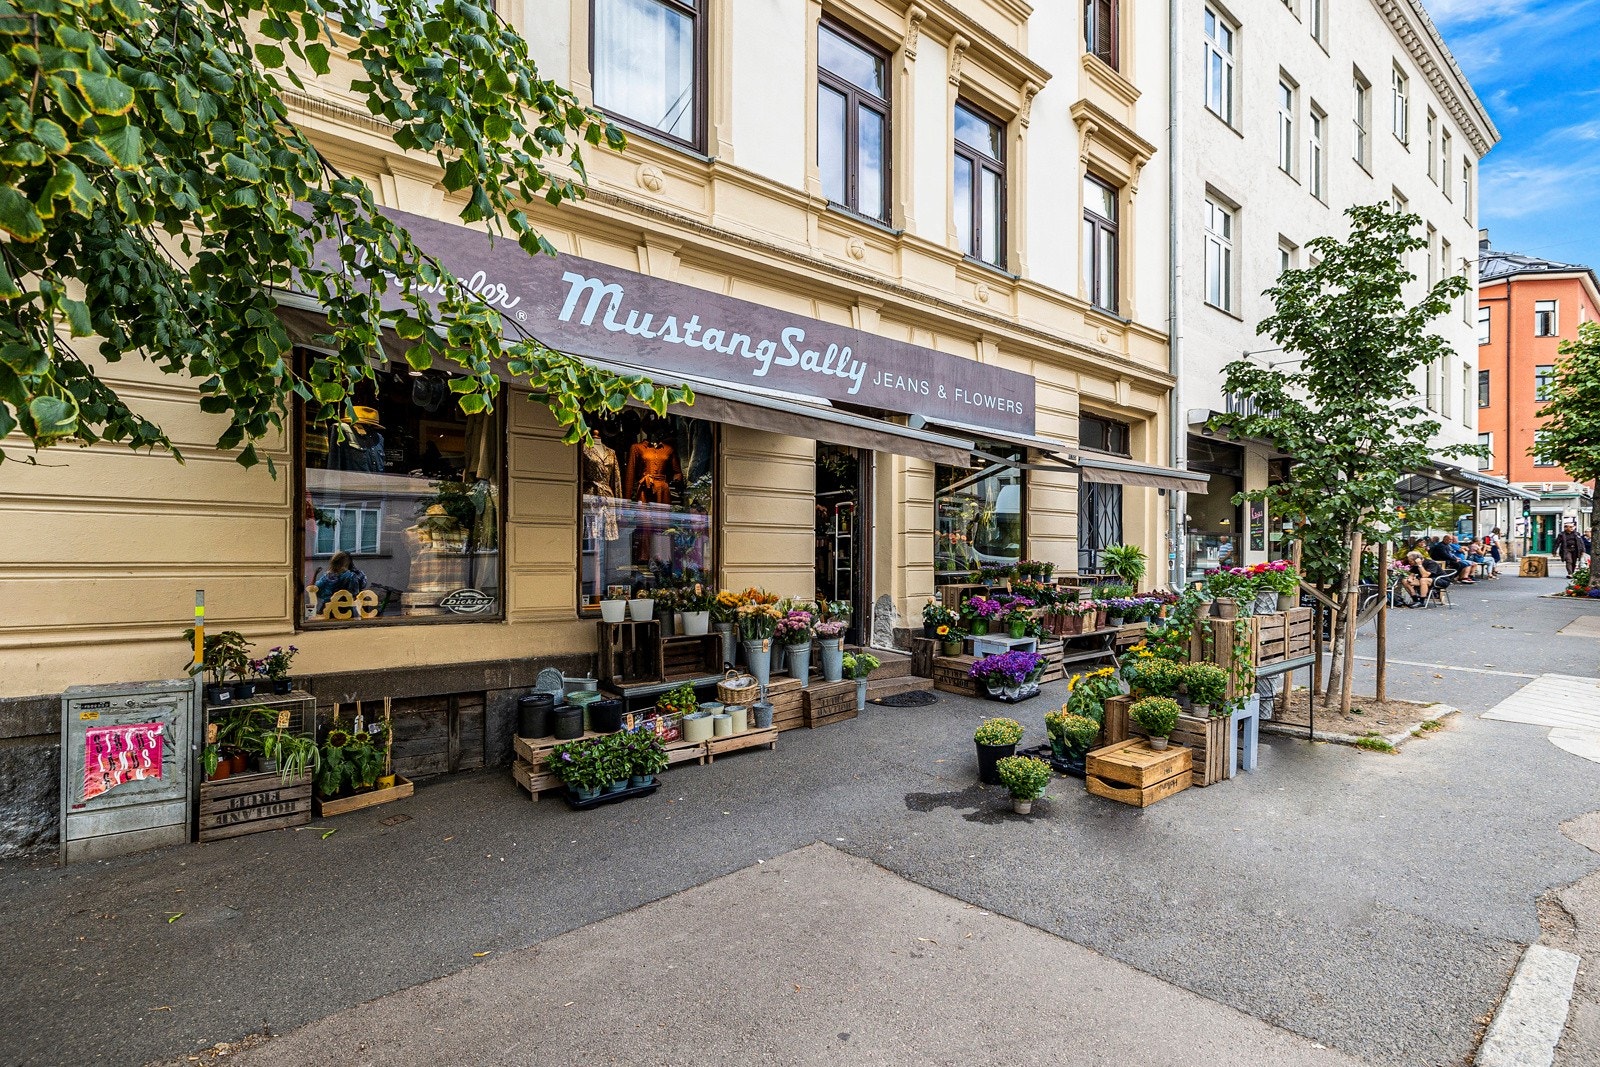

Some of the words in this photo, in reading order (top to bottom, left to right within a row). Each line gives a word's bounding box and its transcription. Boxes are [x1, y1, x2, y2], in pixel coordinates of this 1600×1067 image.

[873, 371, 930, 395] JEANS
[937, 385, 947, 399] &
[955, 388, 1023, 415] FLOWERS
[216, 802, 296, 825] HOLLAND
